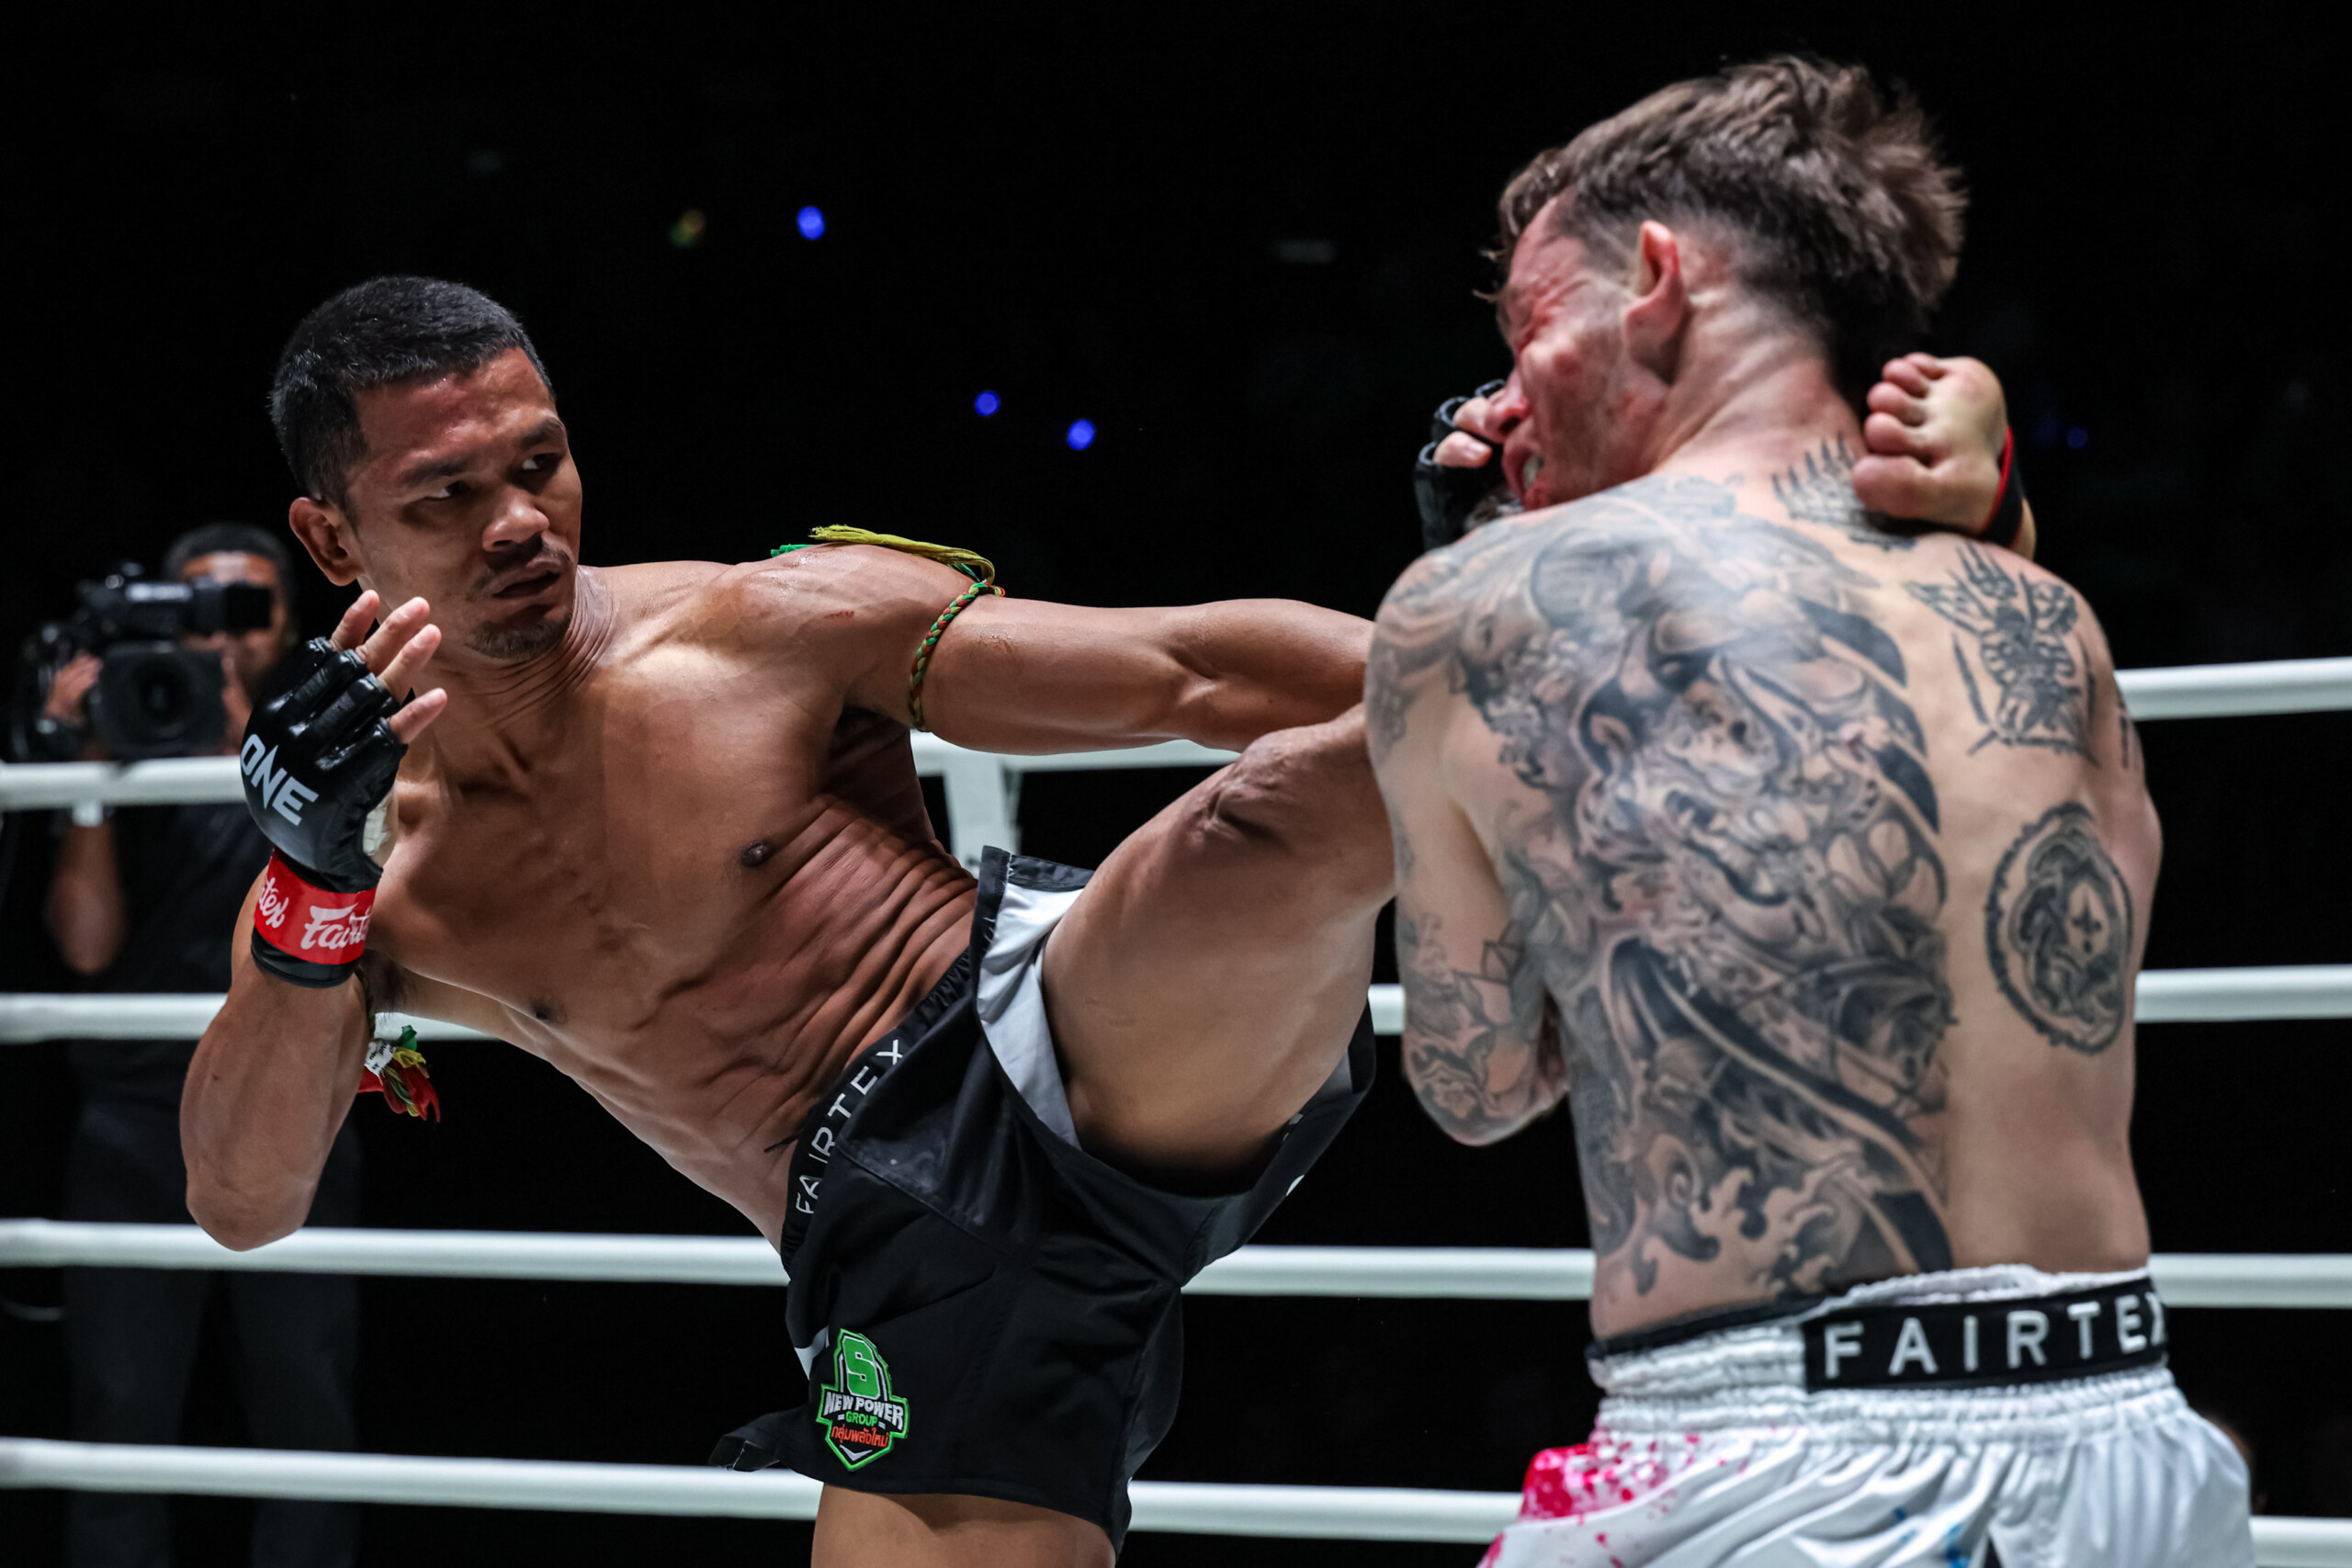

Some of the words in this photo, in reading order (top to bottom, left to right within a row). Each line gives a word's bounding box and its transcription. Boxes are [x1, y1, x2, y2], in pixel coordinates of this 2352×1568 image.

[241, 733, 319, 826] ONE
[795, 1038, 903, 1214] FAIRTEX
[823, 1391, 854, 1416] NEW
[854, 1396, 905, 1431] POWER
[845, 1410, 879, 1427] GROUP
[831, 1425, 889, 1449] กลุ่มพลังใหม่
